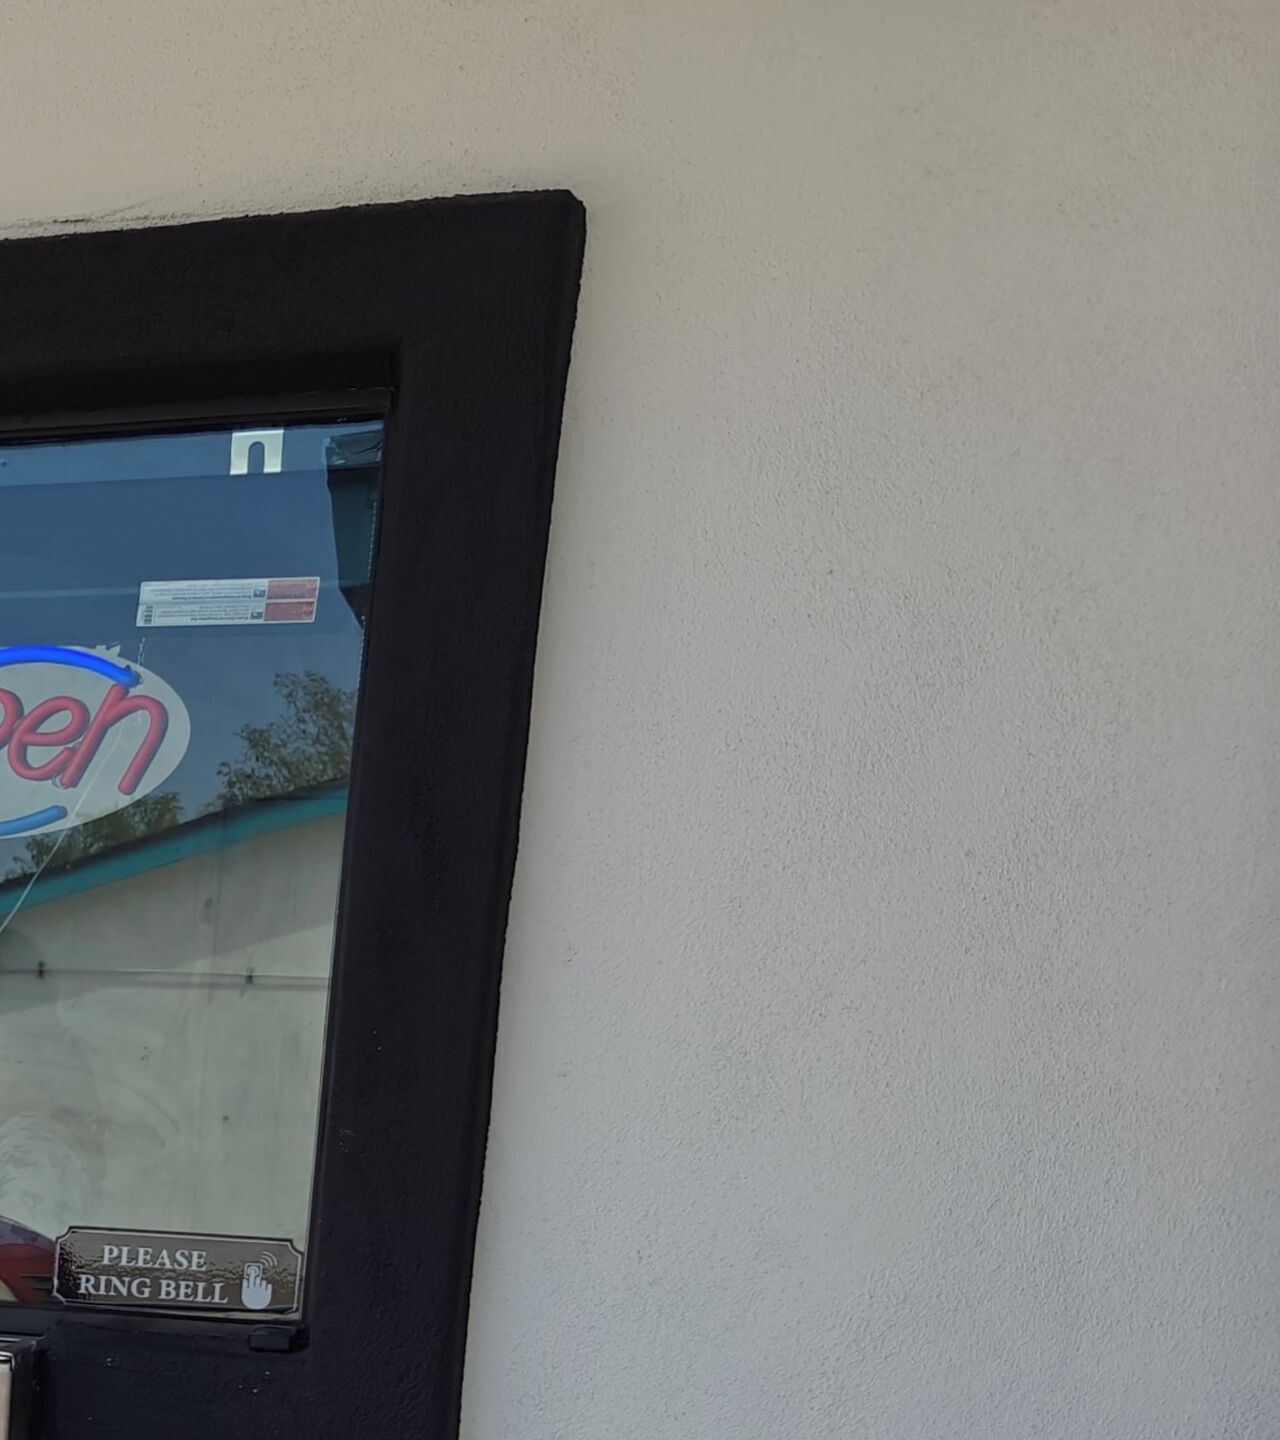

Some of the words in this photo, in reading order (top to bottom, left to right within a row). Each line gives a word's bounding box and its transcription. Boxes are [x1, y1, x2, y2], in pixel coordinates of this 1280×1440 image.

[102, 1244, 208, 1272] PLEASE
[77, 1273, 152, 1298] RING
[157, 1278, 229, 1304] BELL
